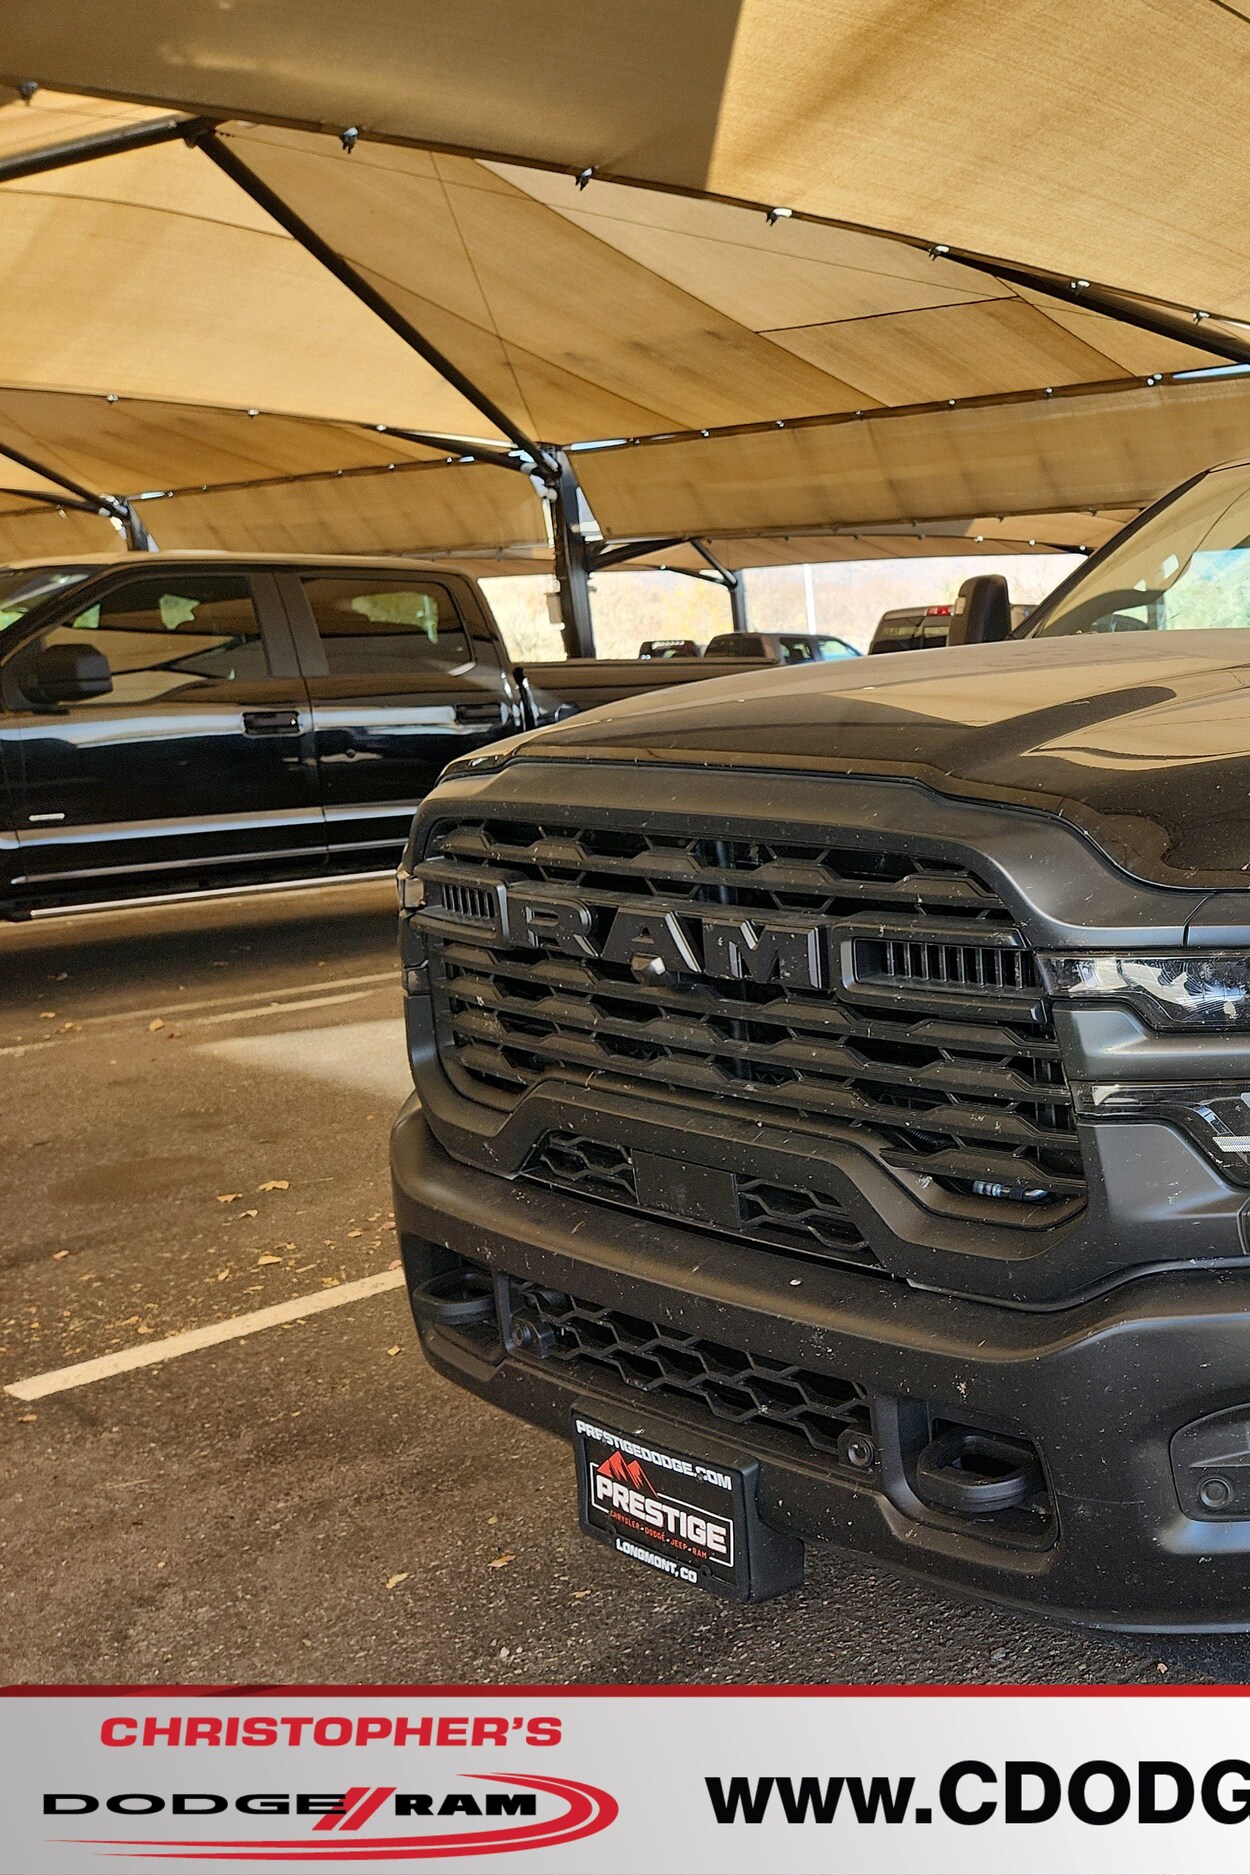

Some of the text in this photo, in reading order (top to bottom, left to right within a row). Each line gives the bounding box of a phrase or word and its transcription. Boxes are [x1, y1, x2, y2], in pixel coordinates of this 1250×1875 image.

[506, 896, 830, 989] RAM
[576, 1420, 732, 1490] PRESTIGEDODGE.COM
[596, 1475, 727, 1554] PRESTIGE
[609, 1510, 707, 1559] CHRYSLER DODGE JEEP RAM
[616, 1538, 697, 1583] LONGMONT, CO
